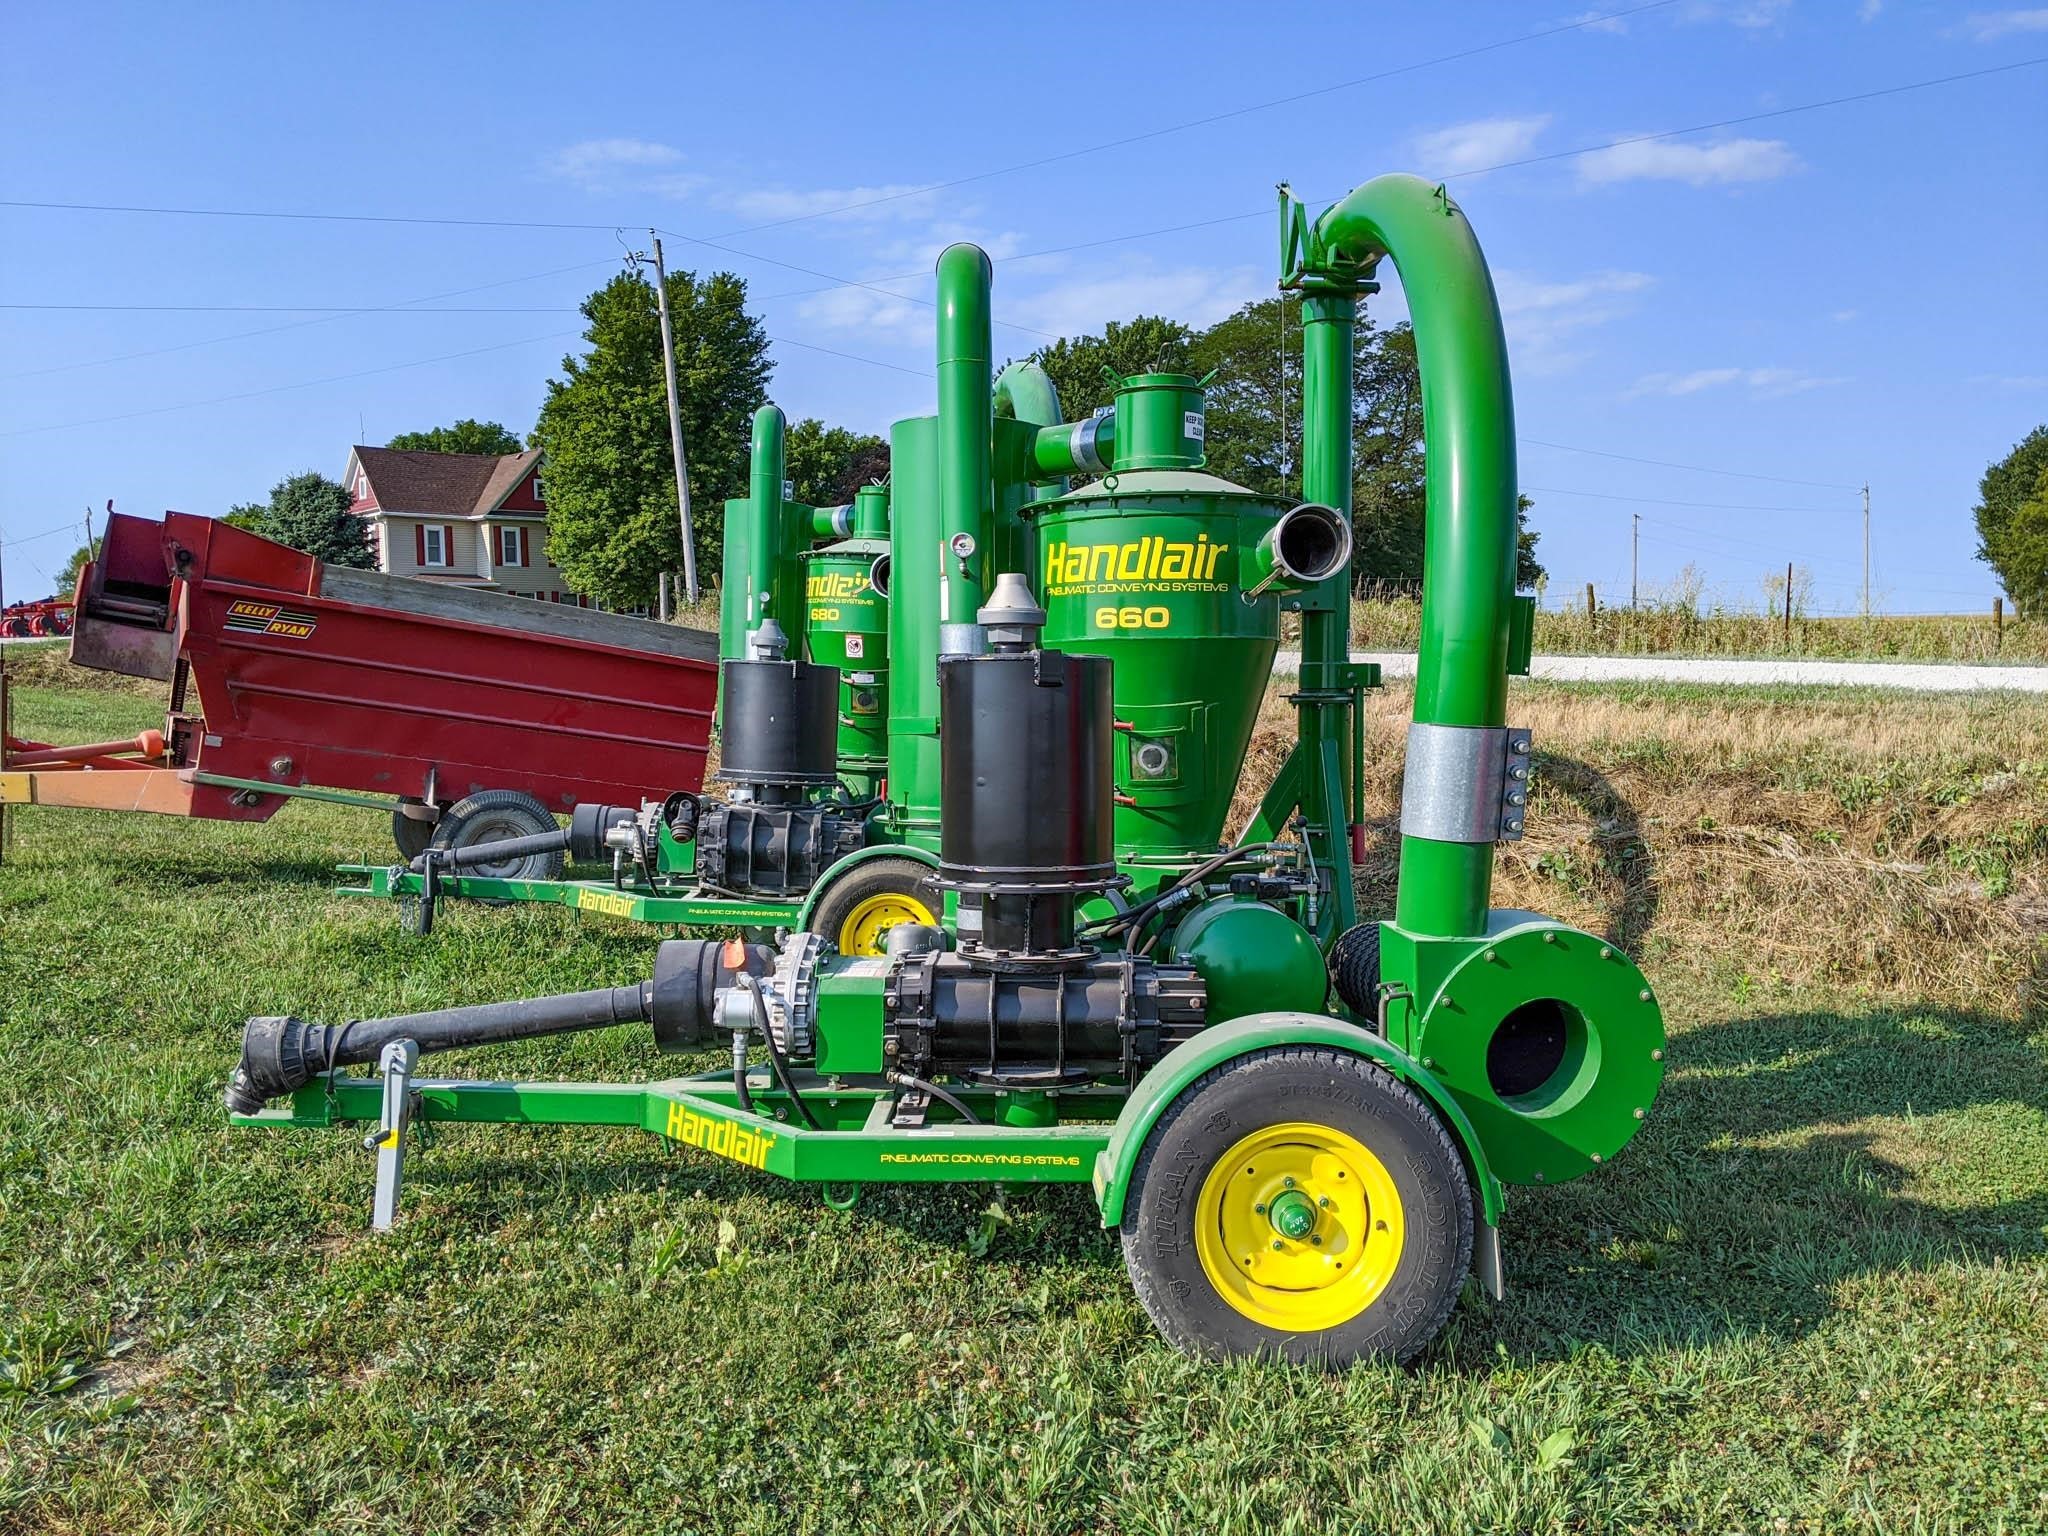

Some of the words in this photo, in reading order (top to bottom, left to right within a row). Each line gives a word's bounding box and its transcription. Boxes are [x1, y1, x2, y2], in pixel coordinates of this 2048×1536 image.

[1046, 534, 1229, 584] Handlair
[1047, 584, 1096, 597] PNEUMATIC
[1097, 582, 1170, 593] CONVEYING
[1171, 582, 1229, 593] SYSTEMS
[234, 604, 275, 617] KELLY
[811, 608, 840, 621] 680
[1095, 607, 1170, 629] 660
[269, 622, 310, 636] RYAN
[577, 888, 637, 917] Handlair
[667, 1100, 777, 1170] Handlair
[880, 1154, 950, 1163] PNEUMATIC
[951, 1154, 1021, 1164] CONVEYING
[1023, 1155, 1080, 1166] SYSTEMS
[1154, 1136, 1201, 1259] TITAN
[1405, 1152, 1449, 1289] RADIAL
